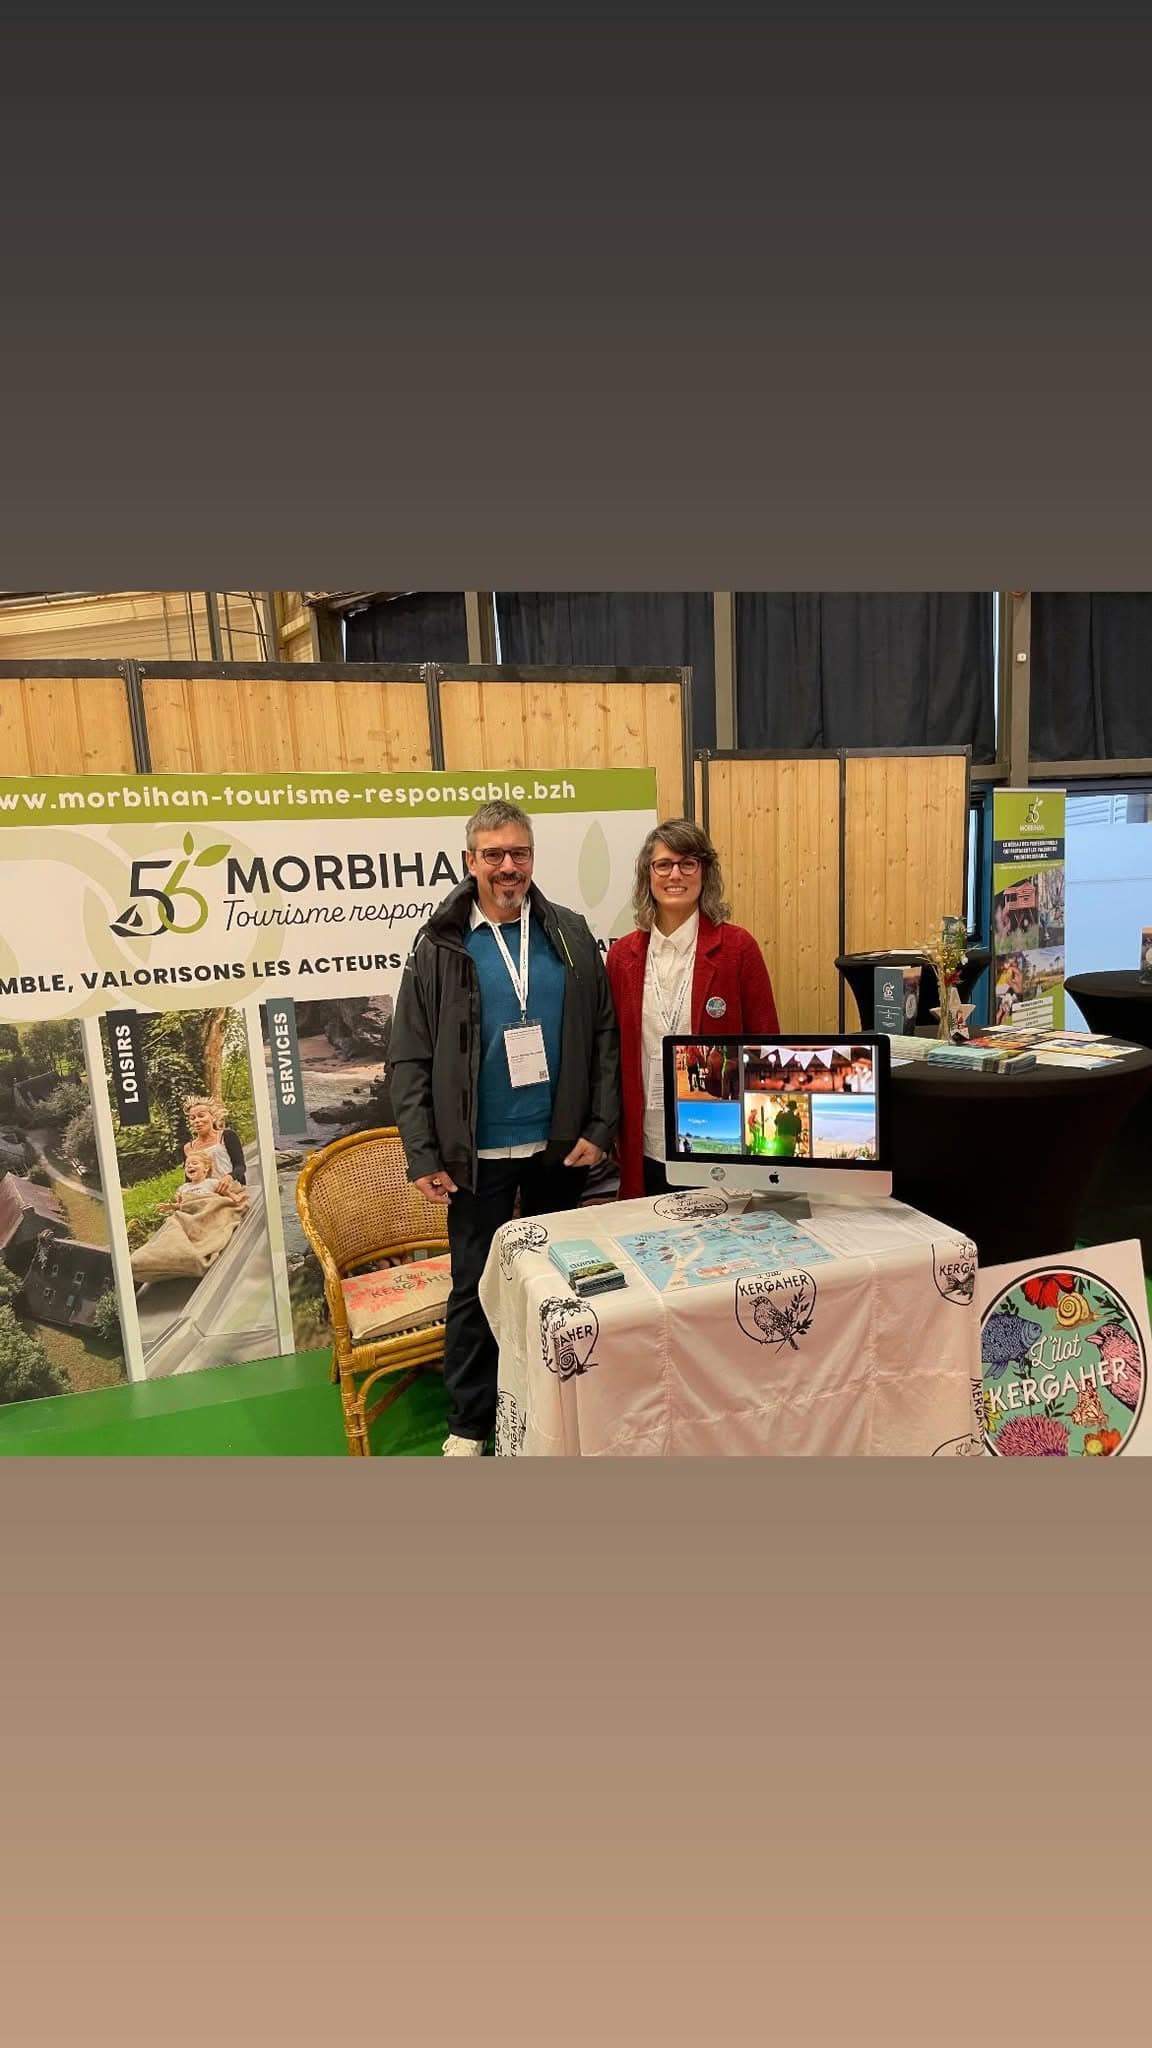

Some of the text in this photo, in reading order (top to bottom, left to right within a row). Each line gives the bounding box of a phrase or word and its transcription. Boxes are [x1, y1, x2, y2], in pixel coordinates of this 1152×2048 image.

[223, 900, 435, 931] Tourisme respon
[0, 953, 401, 995] MBLE, VALORISONS LES ACTEURS
[115, 1024, 139, 1104] LOISIRS
[273, 1012, 296, 1105] SERVICES
[371, 1272, 450, 1299] KERGAHE
[738, 1274, 809, 1297] KERGAHER
[939, 1262, 975, 1277] KERGA
[559, 1324, 593, 1347] AHER
[1031, 1334, 1082, 1371] L'îlot
[989, 1360, 1129, 1414] KERGAHER
